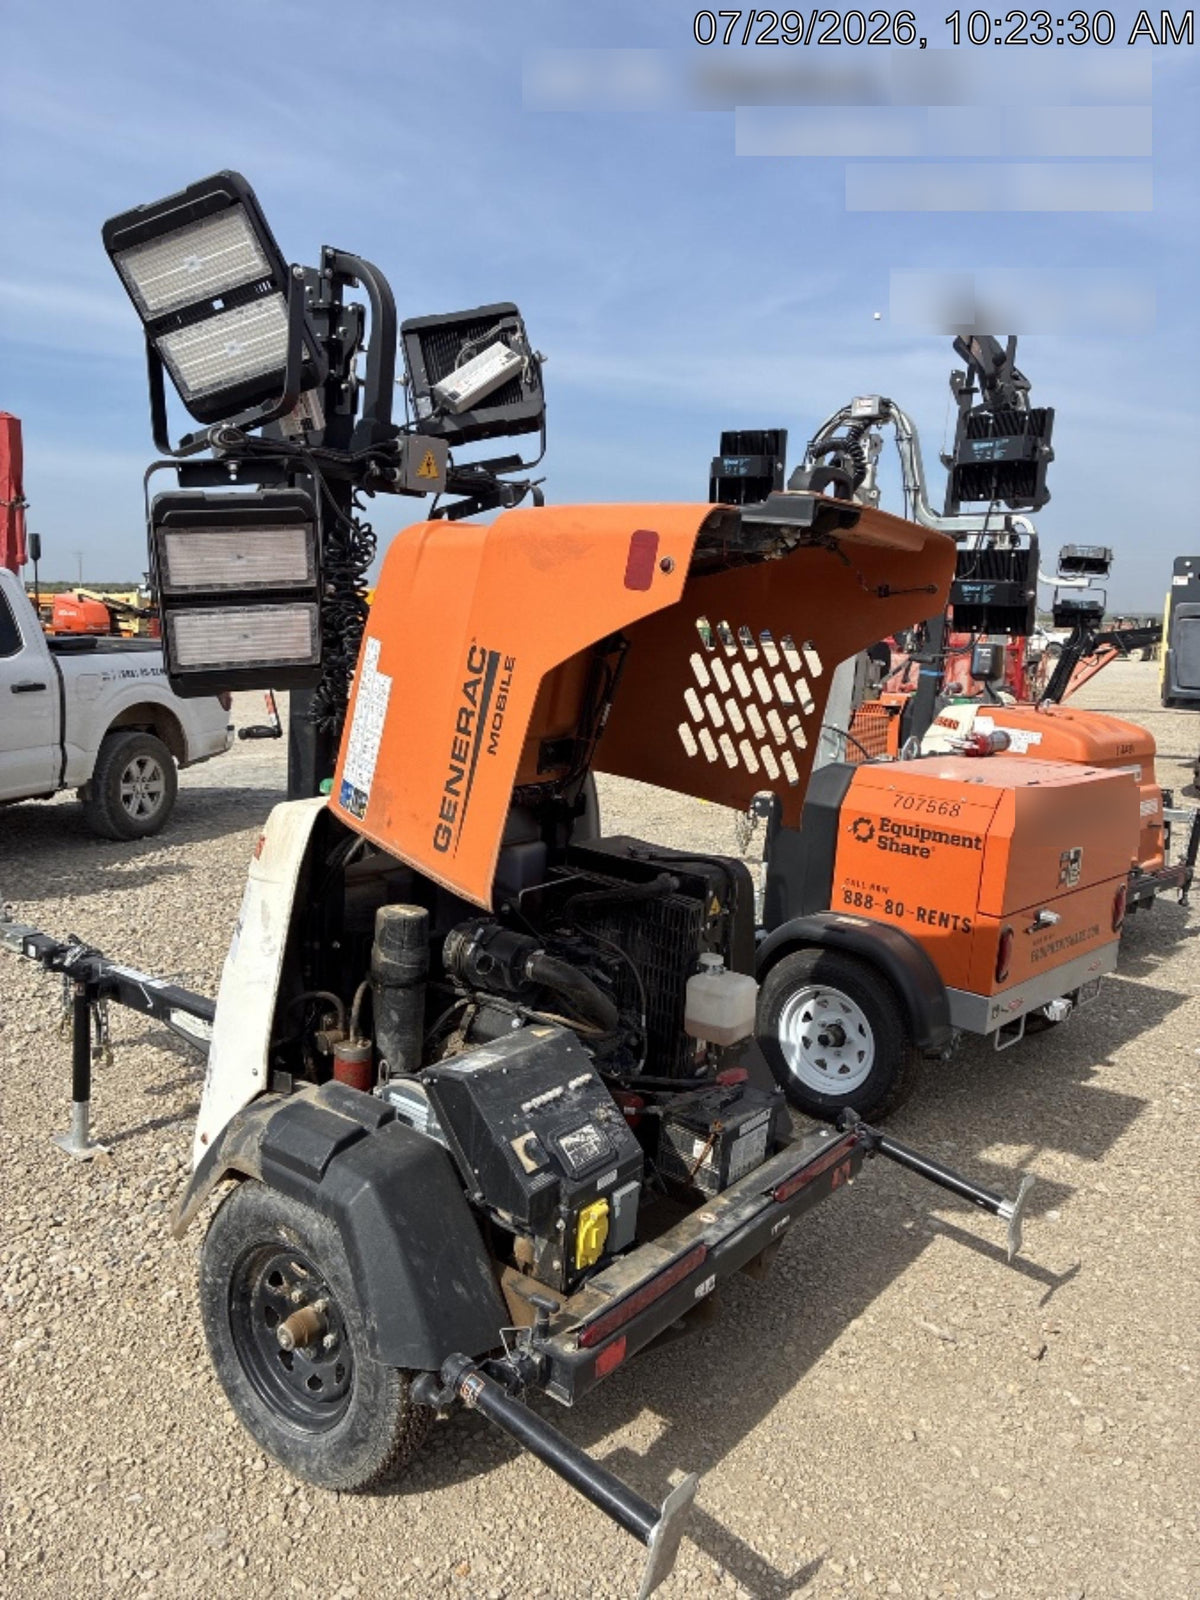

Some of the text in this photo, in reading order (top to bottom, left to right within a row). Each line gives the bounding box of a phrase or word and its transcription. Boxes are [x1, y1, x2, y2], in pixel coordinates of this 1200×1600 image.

[487, 655, 517, 755] MOBILE
[433, 644, 487, 853] GENERAC
[893, 794, 962, 817] 707568
[877, 835, 931, 859] Share
[878, 817, 983, 850] Equipment
[843, 889, 972, 934] 888-80-RENTS
